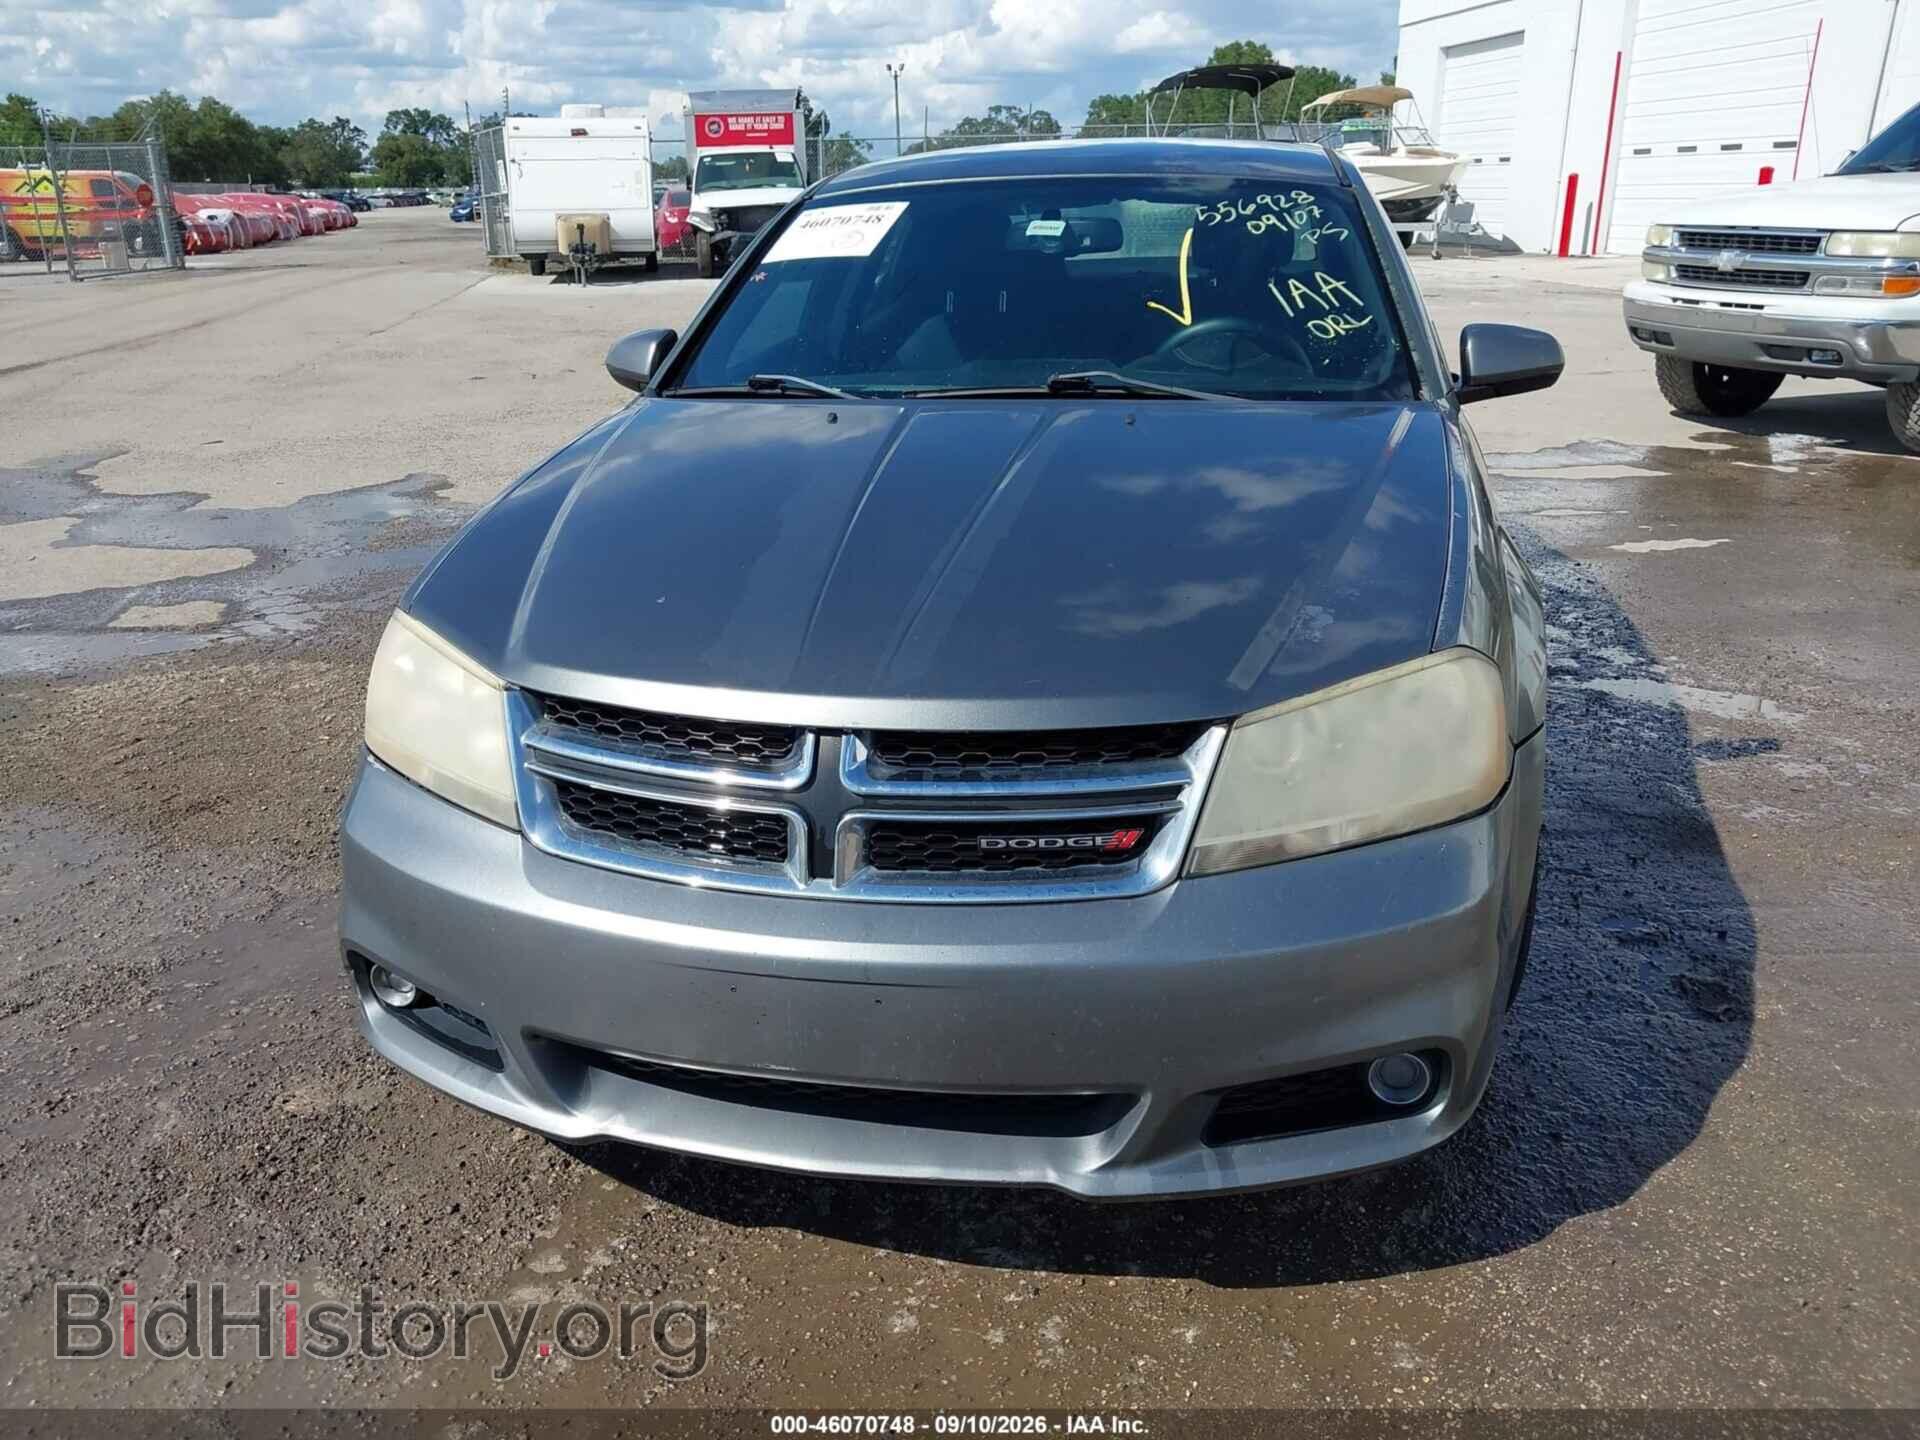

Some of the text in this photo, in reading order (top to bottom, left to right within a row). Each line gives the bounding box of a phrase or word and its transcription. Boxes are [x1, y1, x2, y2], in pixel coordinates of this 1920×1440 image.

[1195, 190, 1315, 226] 556928
[800, 213, 884, 229] 46070748
[1307, 314, 1373, 339] ORL
[980, 835, 1117, 849] DODGE
